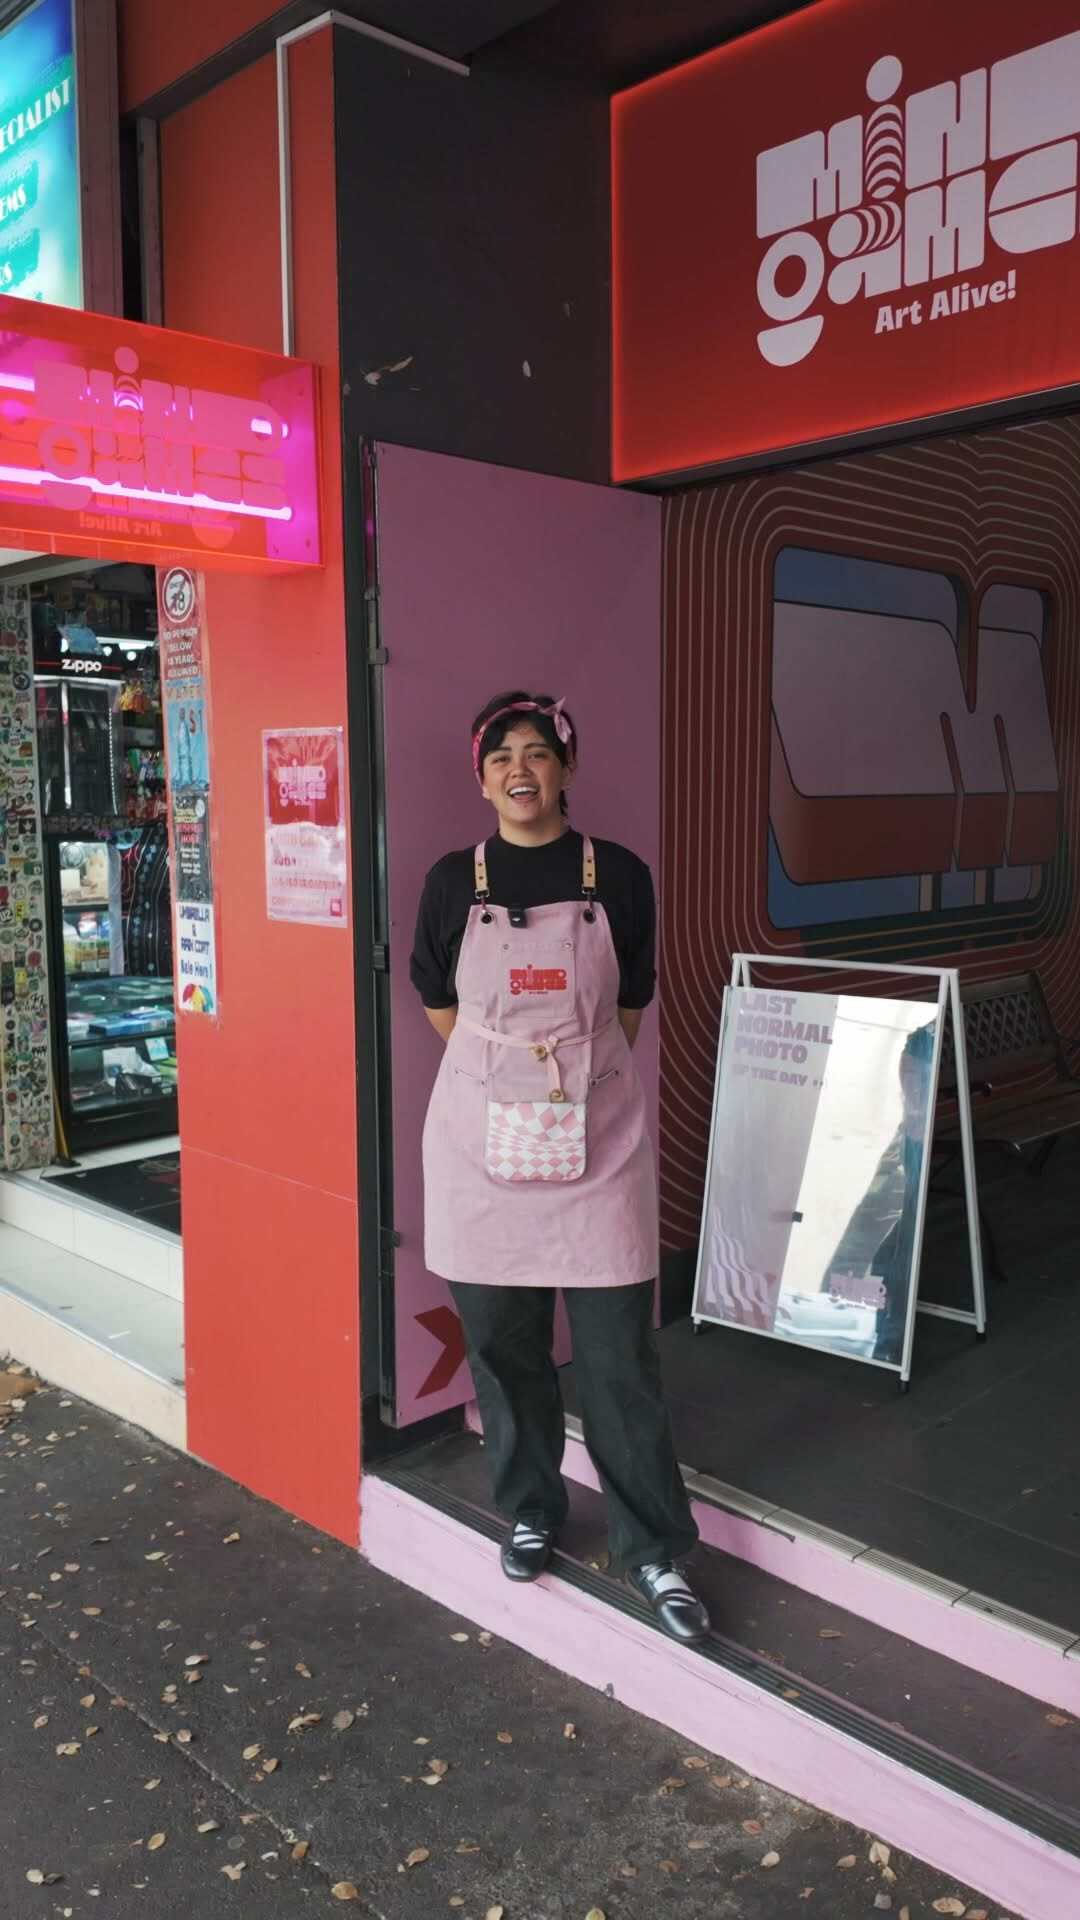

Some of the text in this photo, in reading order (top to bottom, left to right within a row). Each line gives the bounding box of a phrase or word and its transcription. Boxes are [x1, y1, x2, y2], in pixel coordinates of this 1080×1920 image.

[874, 269, 1017, 334] Art Alive!
[61, 658, 102, 673] Zippo
[741, 991, 798, 1016] LAST
[736, 1013, 833, 1045] NORMAL
[734, 1035, 808, 1065] PHOTO
[751, 1066, 777, 1081] THE
[780, 1071, 809, 1087] DAY
